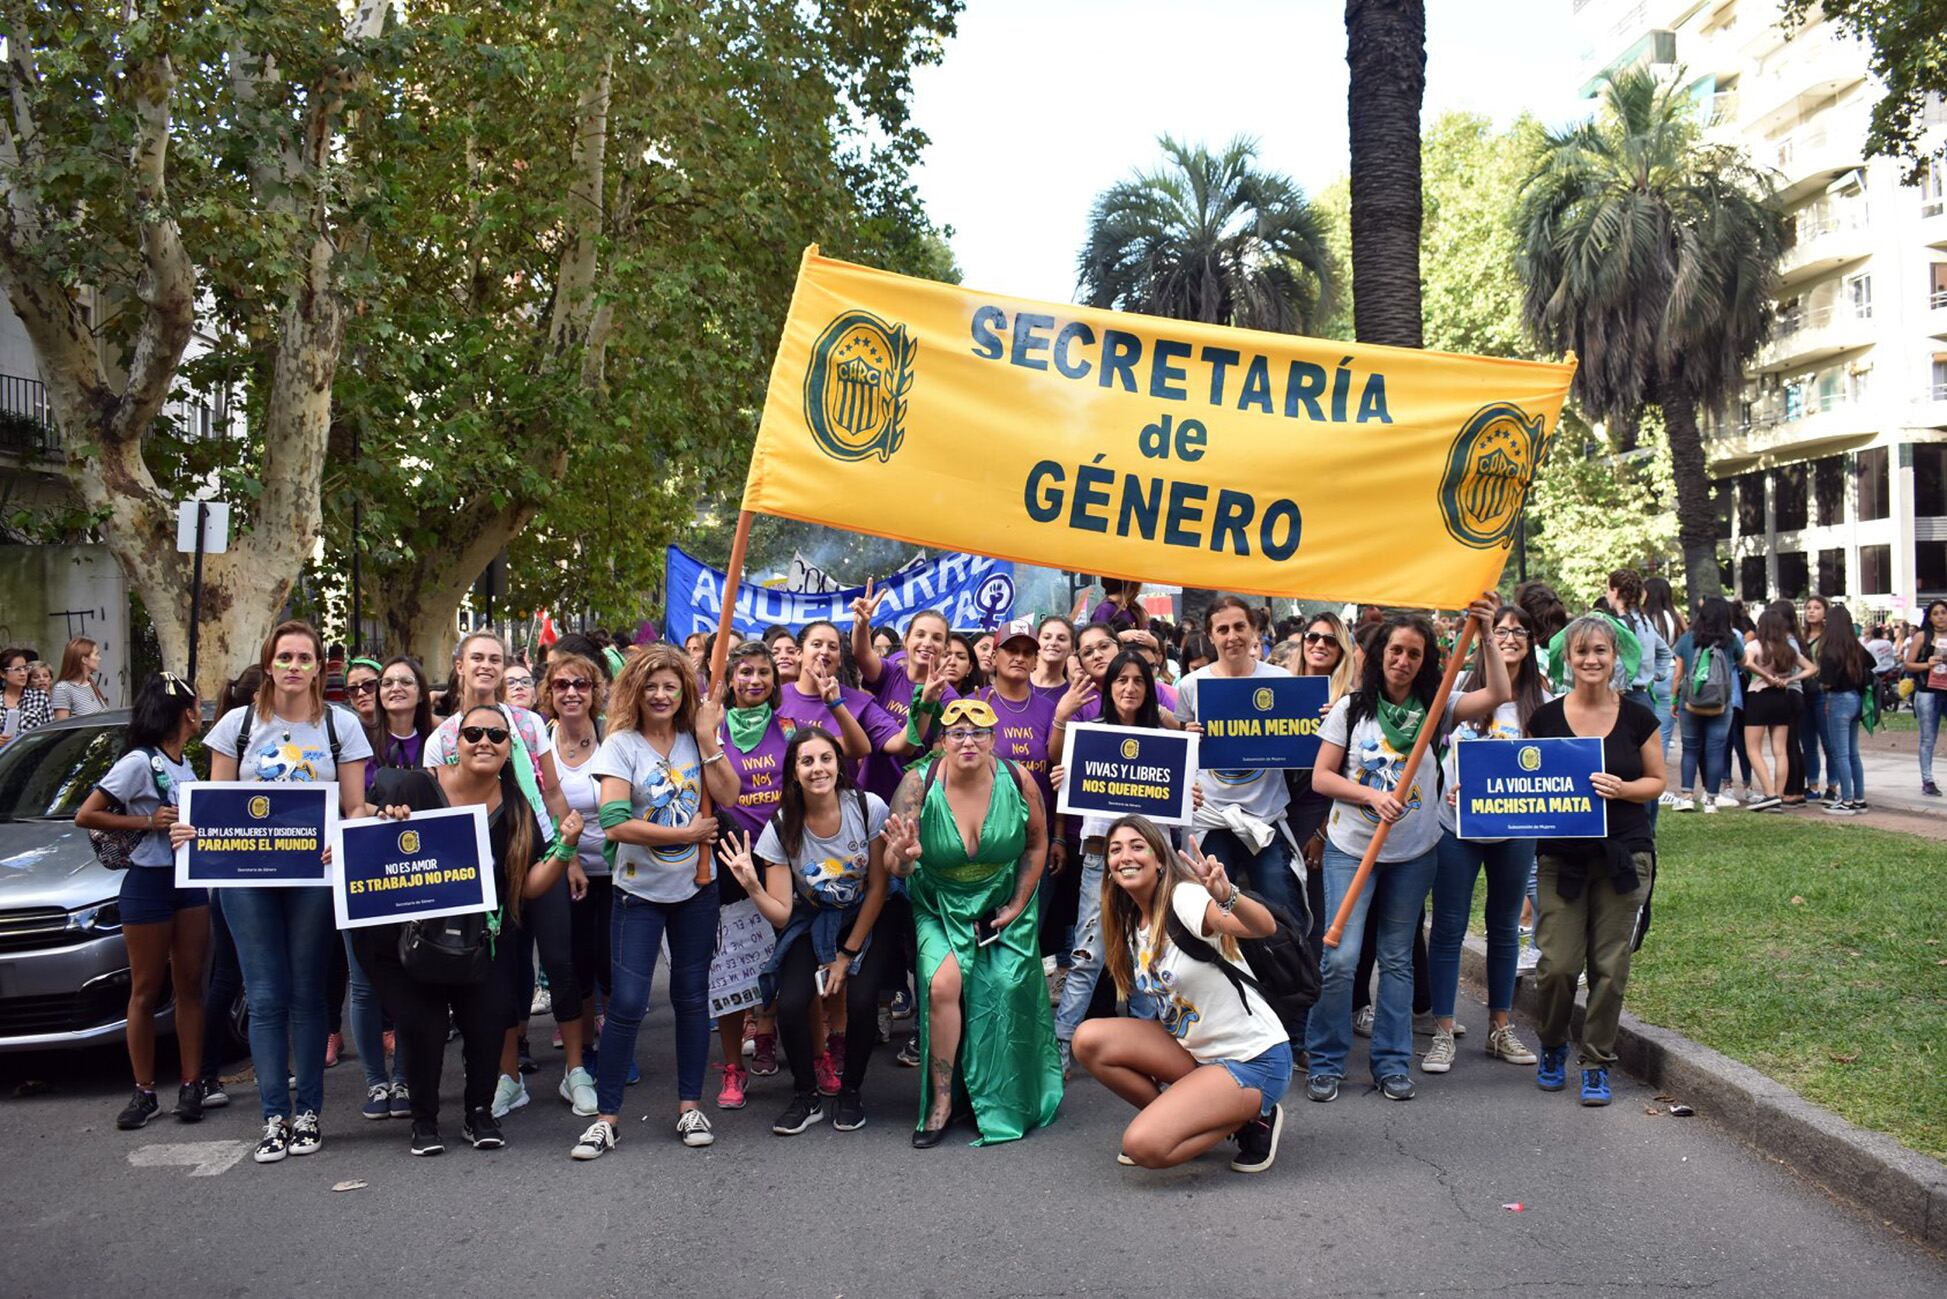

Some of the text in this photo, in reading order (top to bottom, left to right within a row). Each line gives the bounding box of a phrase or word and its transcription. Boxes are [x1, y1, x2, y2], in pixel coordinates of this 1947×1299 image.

[838, 359, 880, 385] CARC
[971, 305, 1394, 424] SECRETARÍA
[1138, 413, 1208, 463] de
[1024, 452, 1302, 562] GÉNERO
[1207, 717, 1321, 737] NI UNA MENOS
[1012, 742, 1030, 756] NOS
[752, 771, 773, 789] NOS
[1085, 760, 1171, 783] VIVAS Y LIBRES
[1082, 779, 1170, 800] NOS QUEREMOS
[1487, 776, 1575, 794] LA VIOLENCIA
[1471, 796, 1592, 814] MACHISTA MATA
[198, 827, 317, 837] EL 8M LAS MUJERES Y DISIDENCIAS
[197, 838, 317, 851] PARAMOS EL MUNDO
[385, 858, 438, 875] NO ES AMOR
[349, 867, 476, 894] ES TRABAJO NO PAGO
